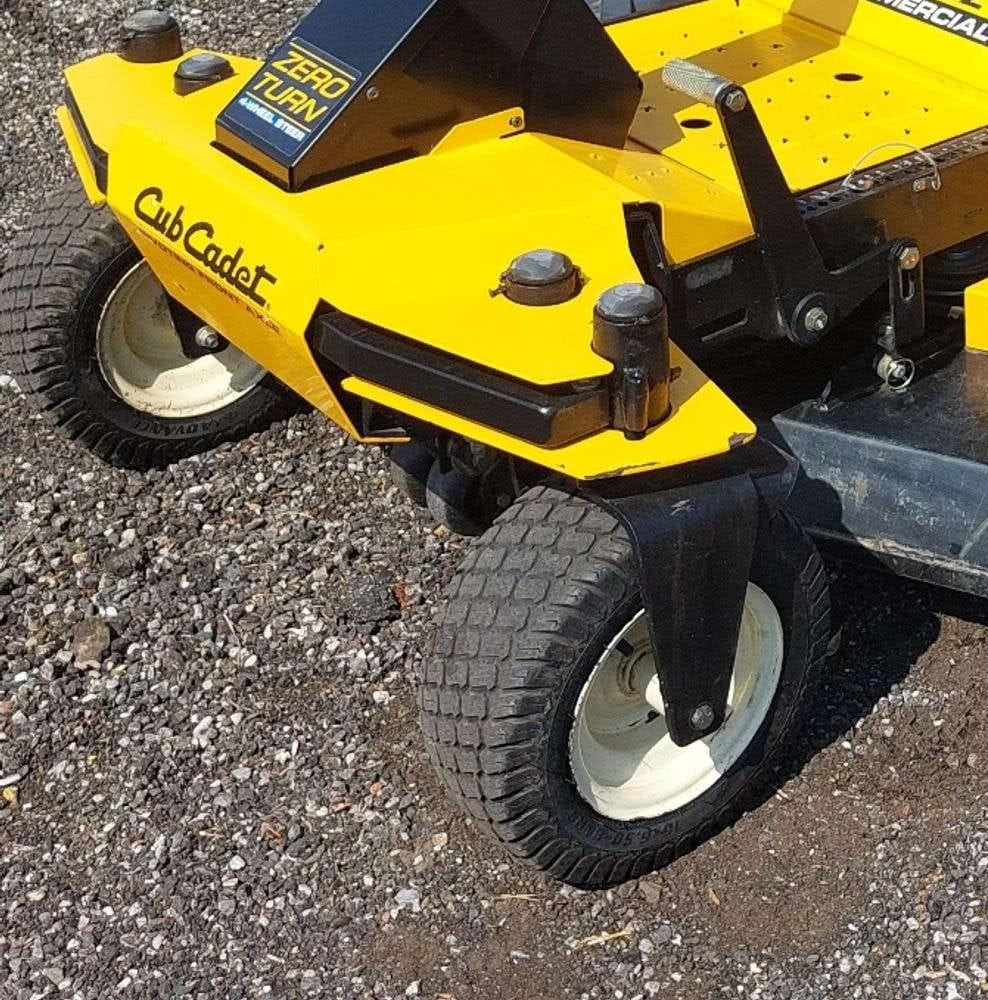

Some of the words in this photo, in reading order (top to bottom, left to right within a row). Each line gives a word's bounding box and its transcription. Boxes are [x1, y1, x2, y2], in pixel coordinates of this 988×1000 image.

[252, 72, 329, 123] TURN
[271, 50, 350, 99] ZERO
[134, 186, 185, 242] Cub
[183, 221, 278, 308] Cadet
